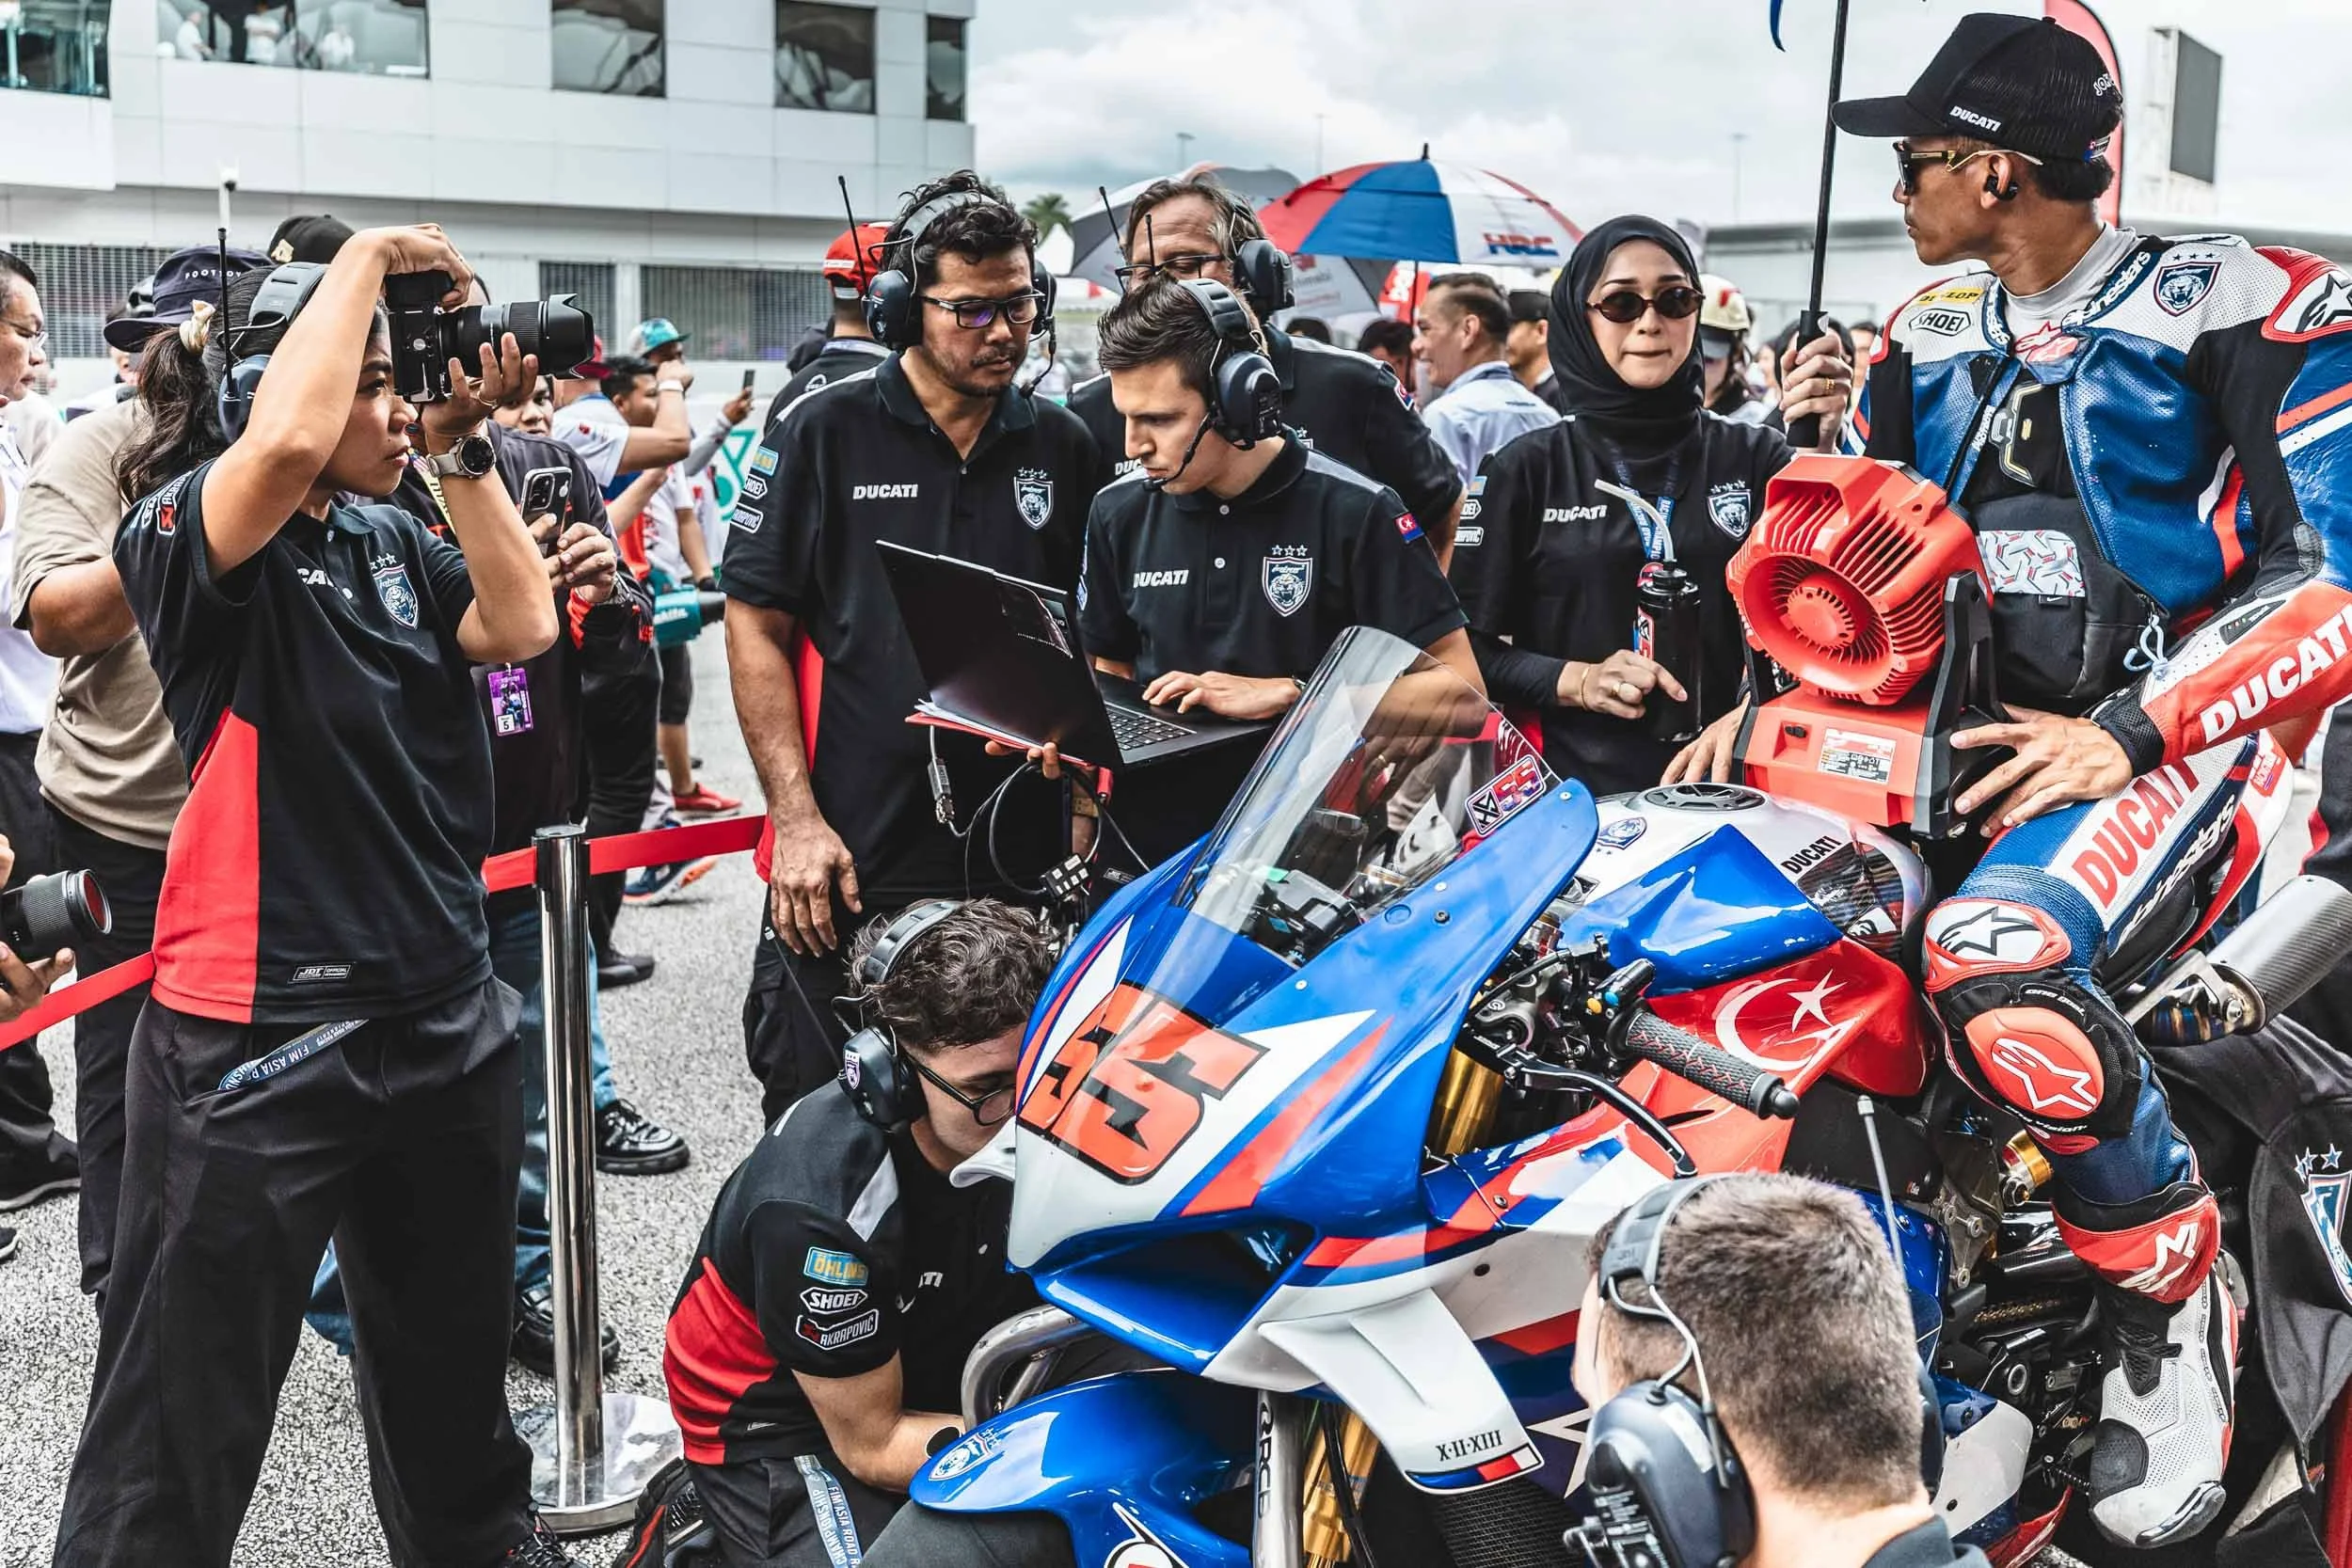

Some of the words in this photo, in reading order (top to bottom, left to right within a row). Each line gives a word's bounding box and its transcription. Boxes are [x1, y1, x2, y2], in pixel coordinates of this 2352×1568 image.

[1949, 105, 2002, 133] DUCATI
[1484, 232, 1560, 257] HRC
[185, 269, 242, 279] FOOTOY
[1919, 312, 1964, 332] SHOEI
[1115, 458, 1142, 476] DUC
[744, 478, 764, 496] HOEI
[852, 483, 919, 500] DUCATI
[1543, 505, 1608, 523] DUCATI
[1134, 569, 1189, 588] DUCATI
[503, 721, 510, 731] 5
[1781, 835, 1842, 875] DUCATI
[289, 1044, 310, 1063] FIM
[262, 1057, 287, 1075] ASIA
[1016, 978, 1271, 1186] 55
[809, 1291, 859, 1309] SHOEI
[828, 1486, 843, 1504] FIM
[834, 1505, 851, 1527] ASIA
[812, 1489, 848, 1565] CHAMPIONSHIP
[843, 1528, 858, 1555] ROAD
